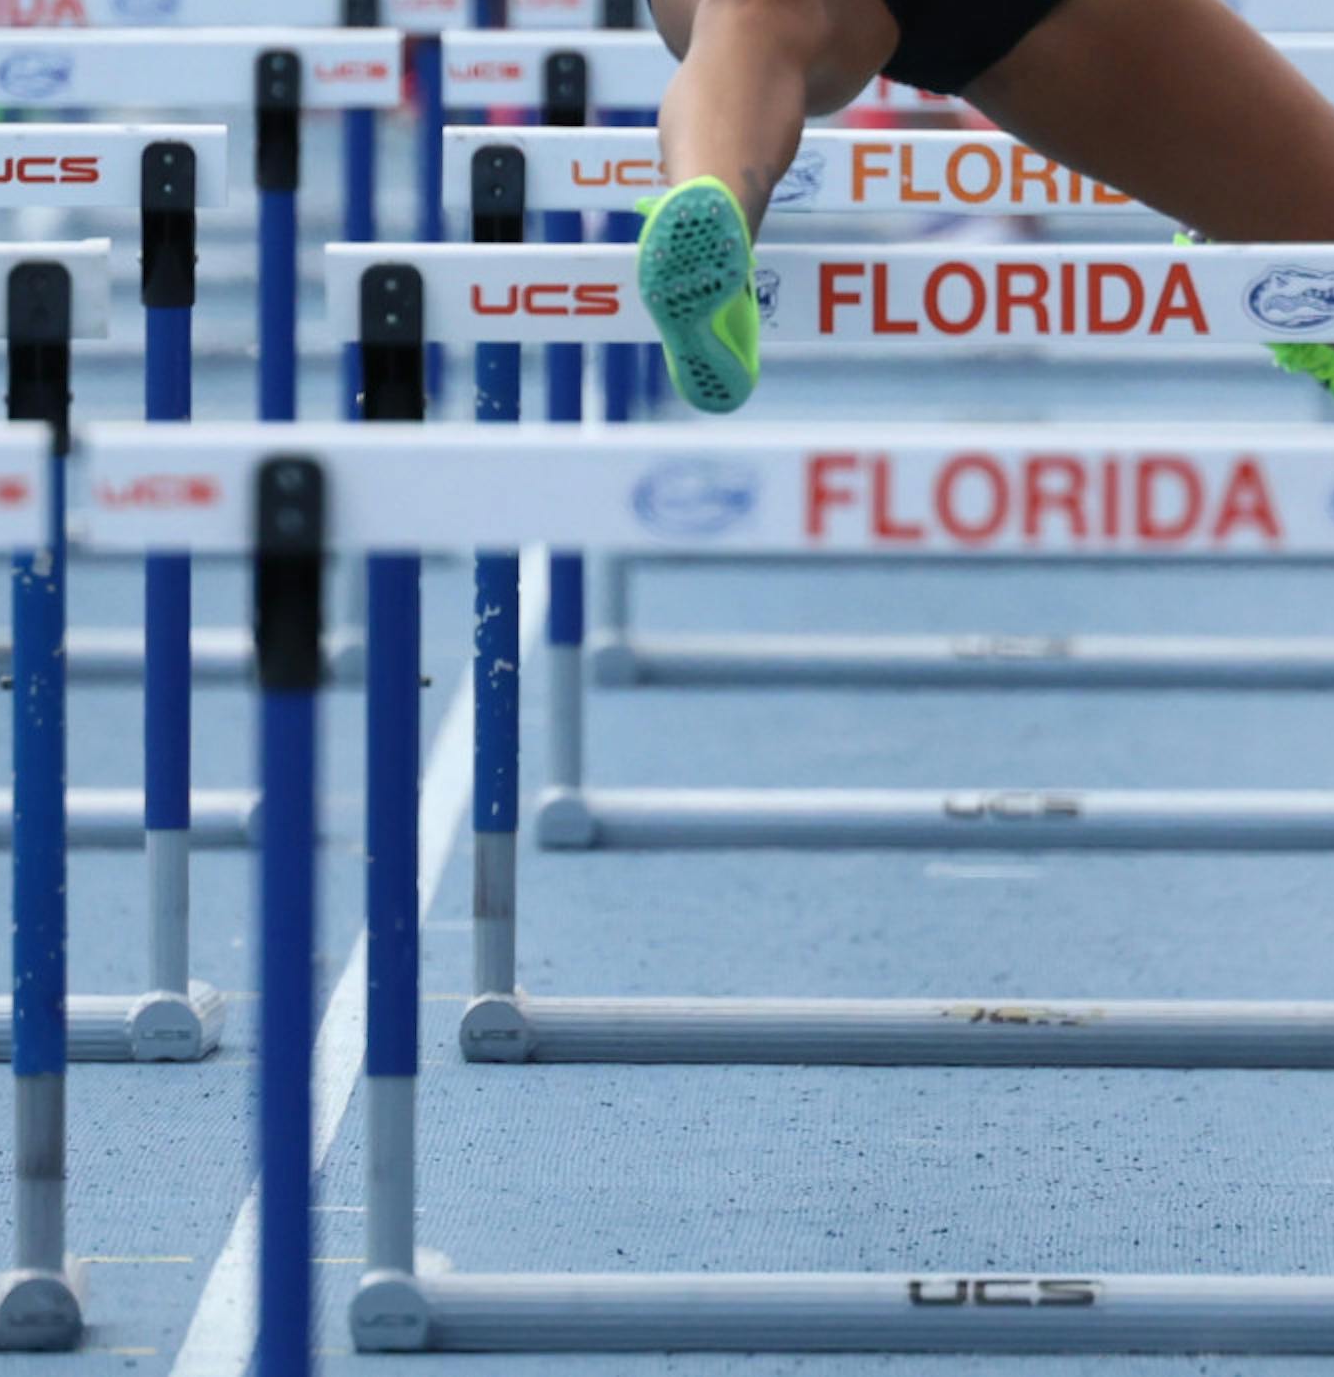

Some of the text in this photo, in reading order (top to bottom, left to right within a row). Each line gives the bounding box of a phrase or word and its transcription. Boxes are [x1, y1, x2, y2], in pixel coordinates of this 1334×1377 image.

[571, 159, 671, 187] UC
[470, 283, 621, 316] UCS
[819, 262, 1209, 335] FLORIDA
[806, 453, 1280, 543] FLORIDA
[910, 1280, 1095, 1307] UCS
